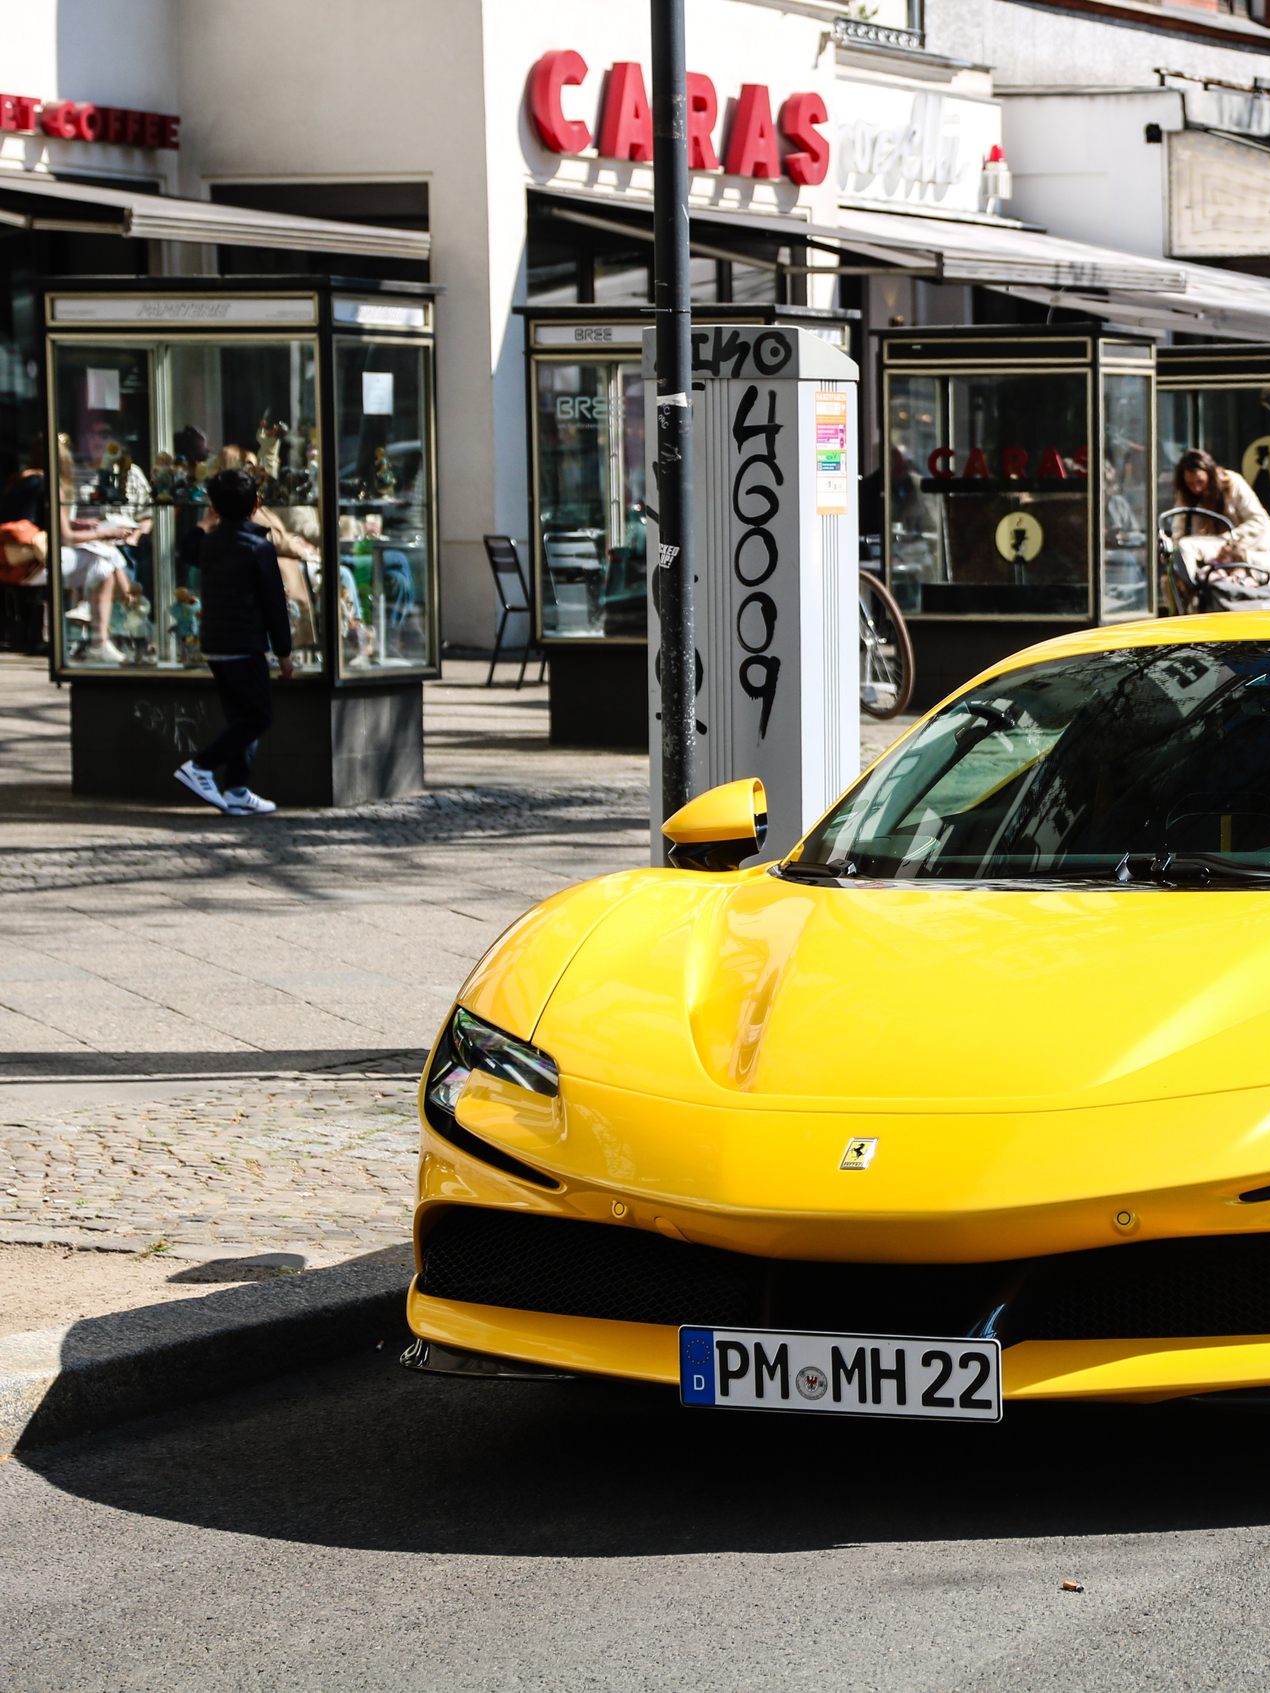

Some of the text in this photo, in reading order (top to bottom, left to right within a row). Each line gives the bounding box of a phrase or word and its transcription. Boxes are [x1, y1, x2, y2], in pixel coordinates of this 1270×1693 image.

[45, 100, 181, 149] COFFEE
[532, 50, 830, 185] CARAS
[136, 301, 231, 317] PAPETERIE
[574, 328, 613, 341] BREE
[556, 396, 626, 419] BREE
[693, 1375, 705, 1391] D
[715, 1340, 790, 1400] PM
[831, 1345, 907, 1406] MH
[921, 1350, 993, 1410] 22
